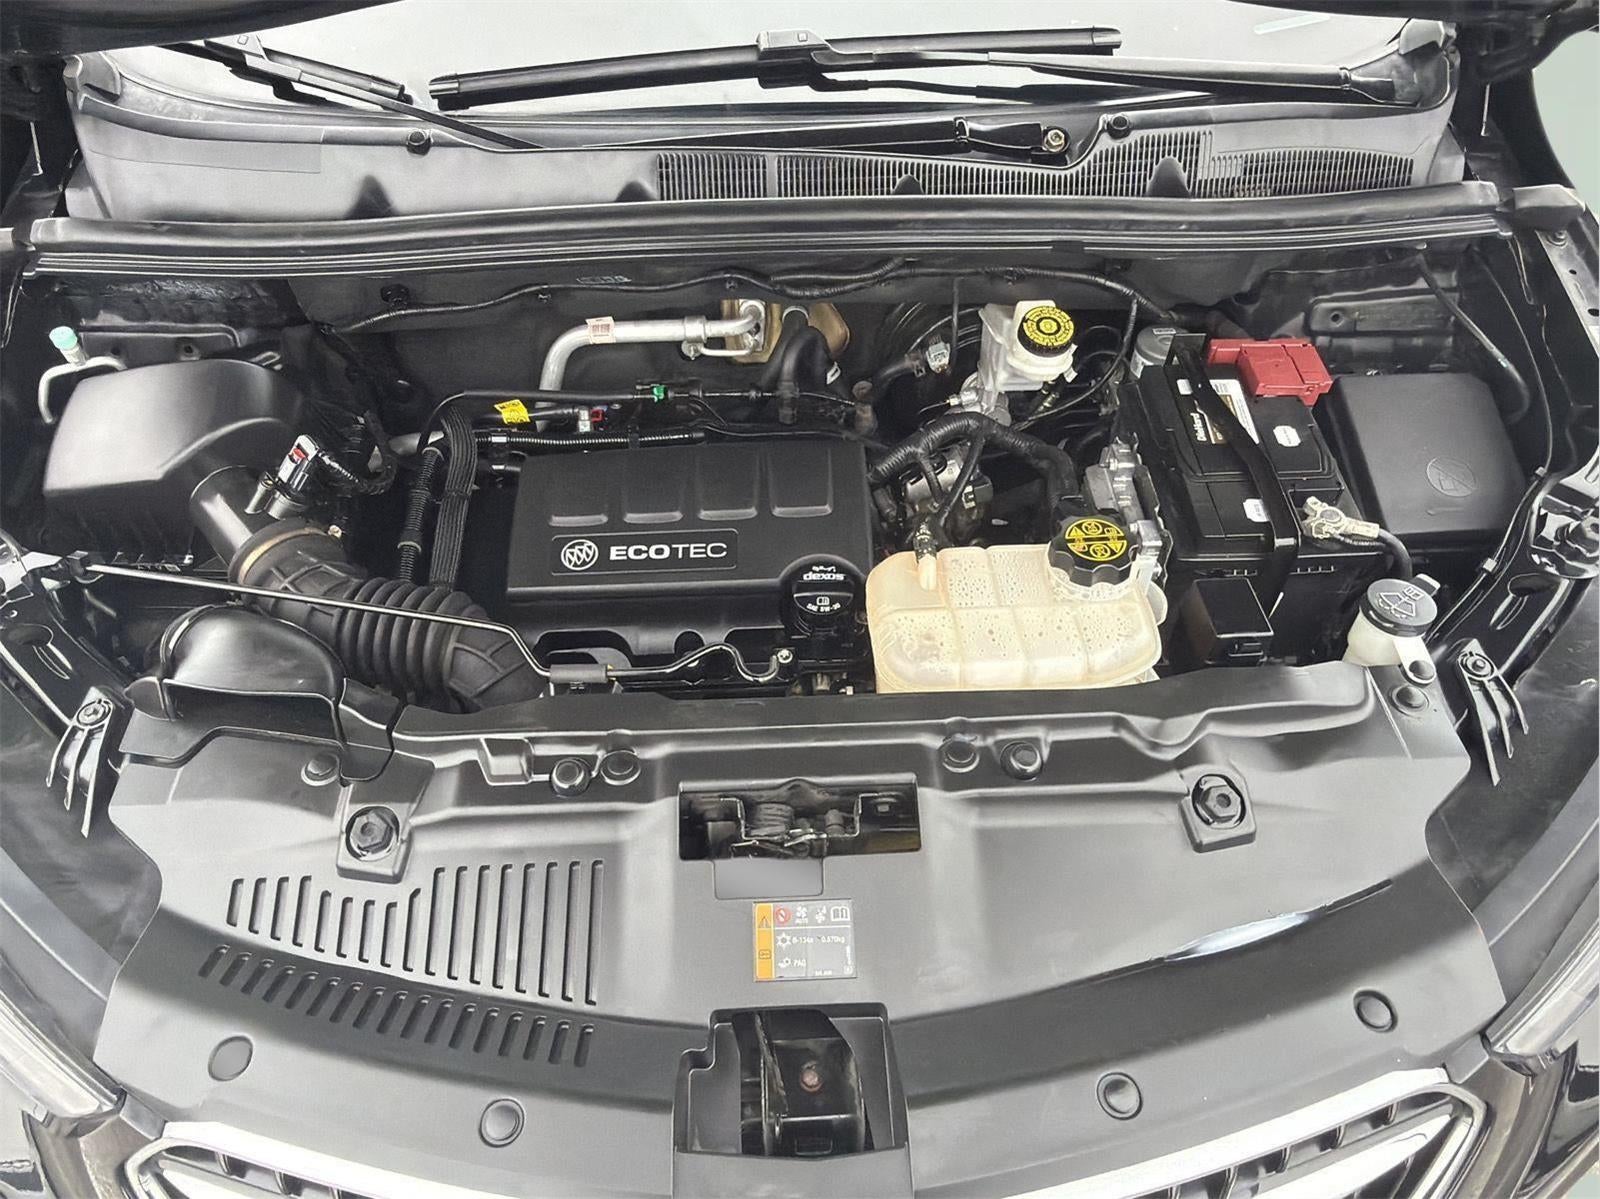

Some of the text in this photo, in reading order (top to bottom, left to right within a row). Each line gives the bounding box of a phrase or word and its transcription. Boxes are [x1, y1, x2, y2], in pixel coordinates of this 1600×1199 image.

[1190, 412, 1208, 442] DieHard
[609, 542, 728, 561] ECOTEC
[802, 571, 846, 581] dexos
